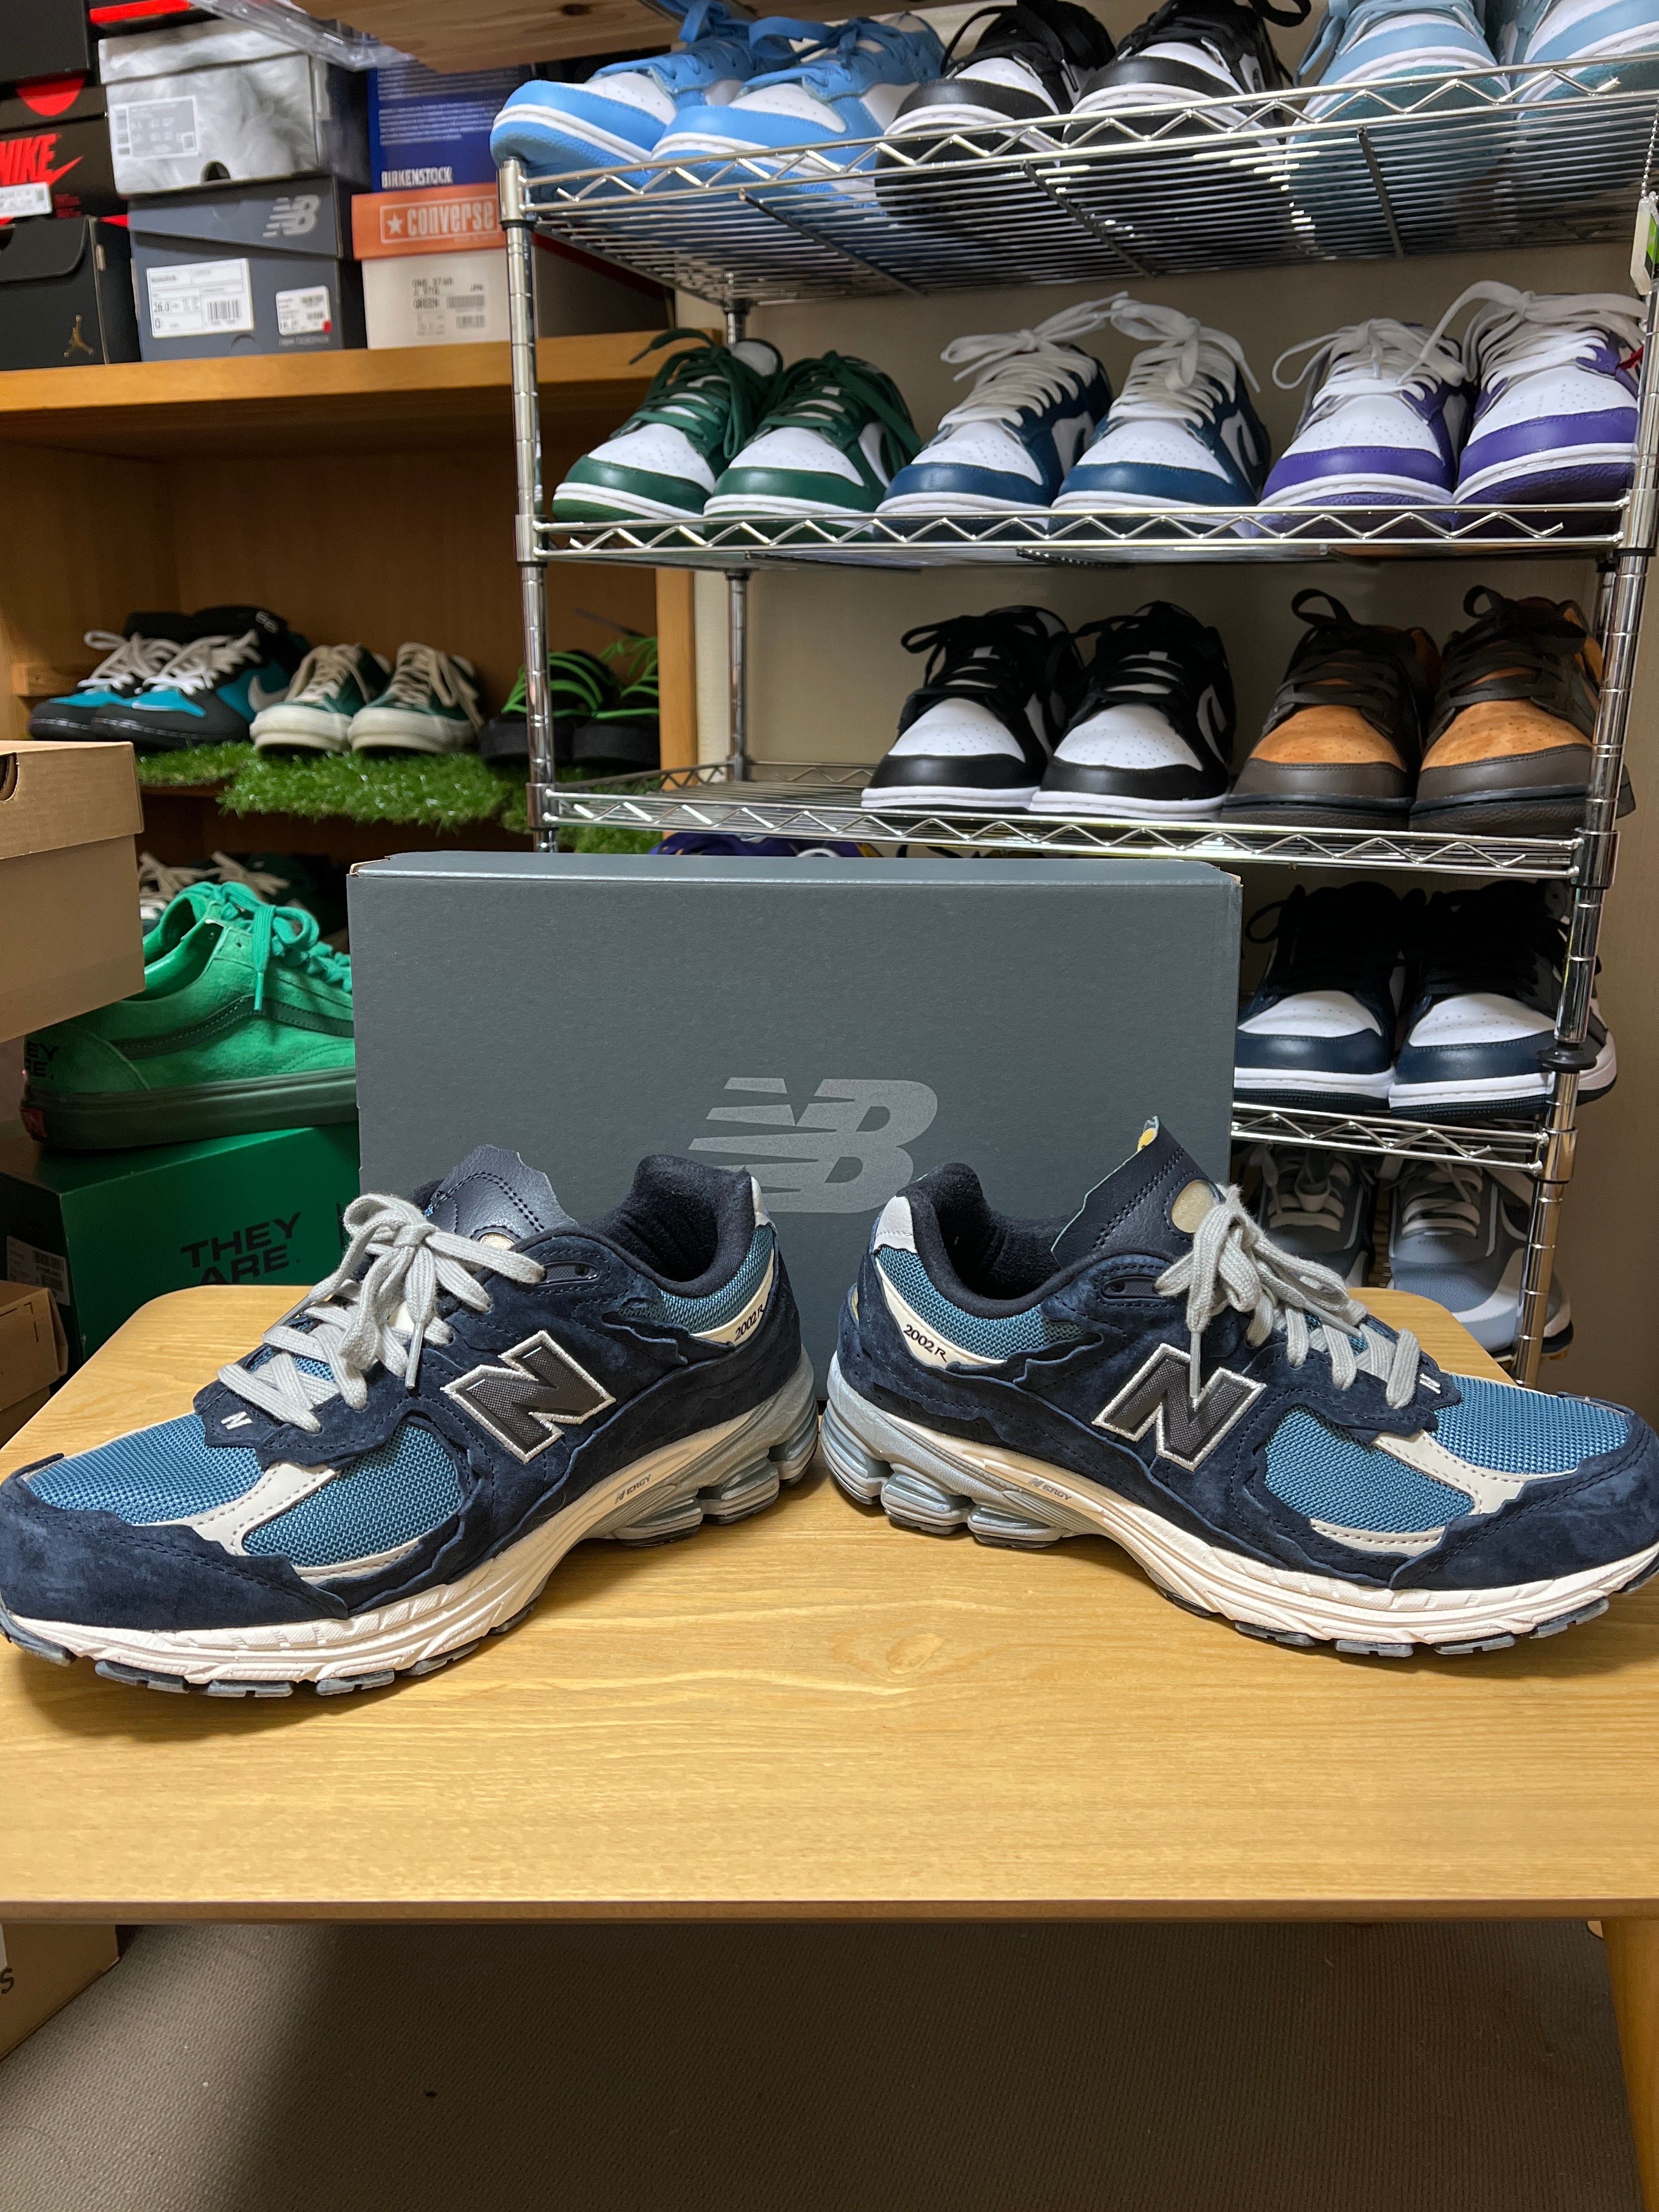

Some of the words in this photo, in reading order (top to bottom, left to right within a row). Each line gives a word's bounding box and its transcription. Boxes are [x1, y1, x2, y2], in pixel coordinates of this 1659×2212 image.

[381, 166, 453, 189] BIRKENSTOCK
[180, 1211, 301, 1269] THEY
[440, 1330, 617, 1465] N
[1091, 1342, 1268, 1472] N
